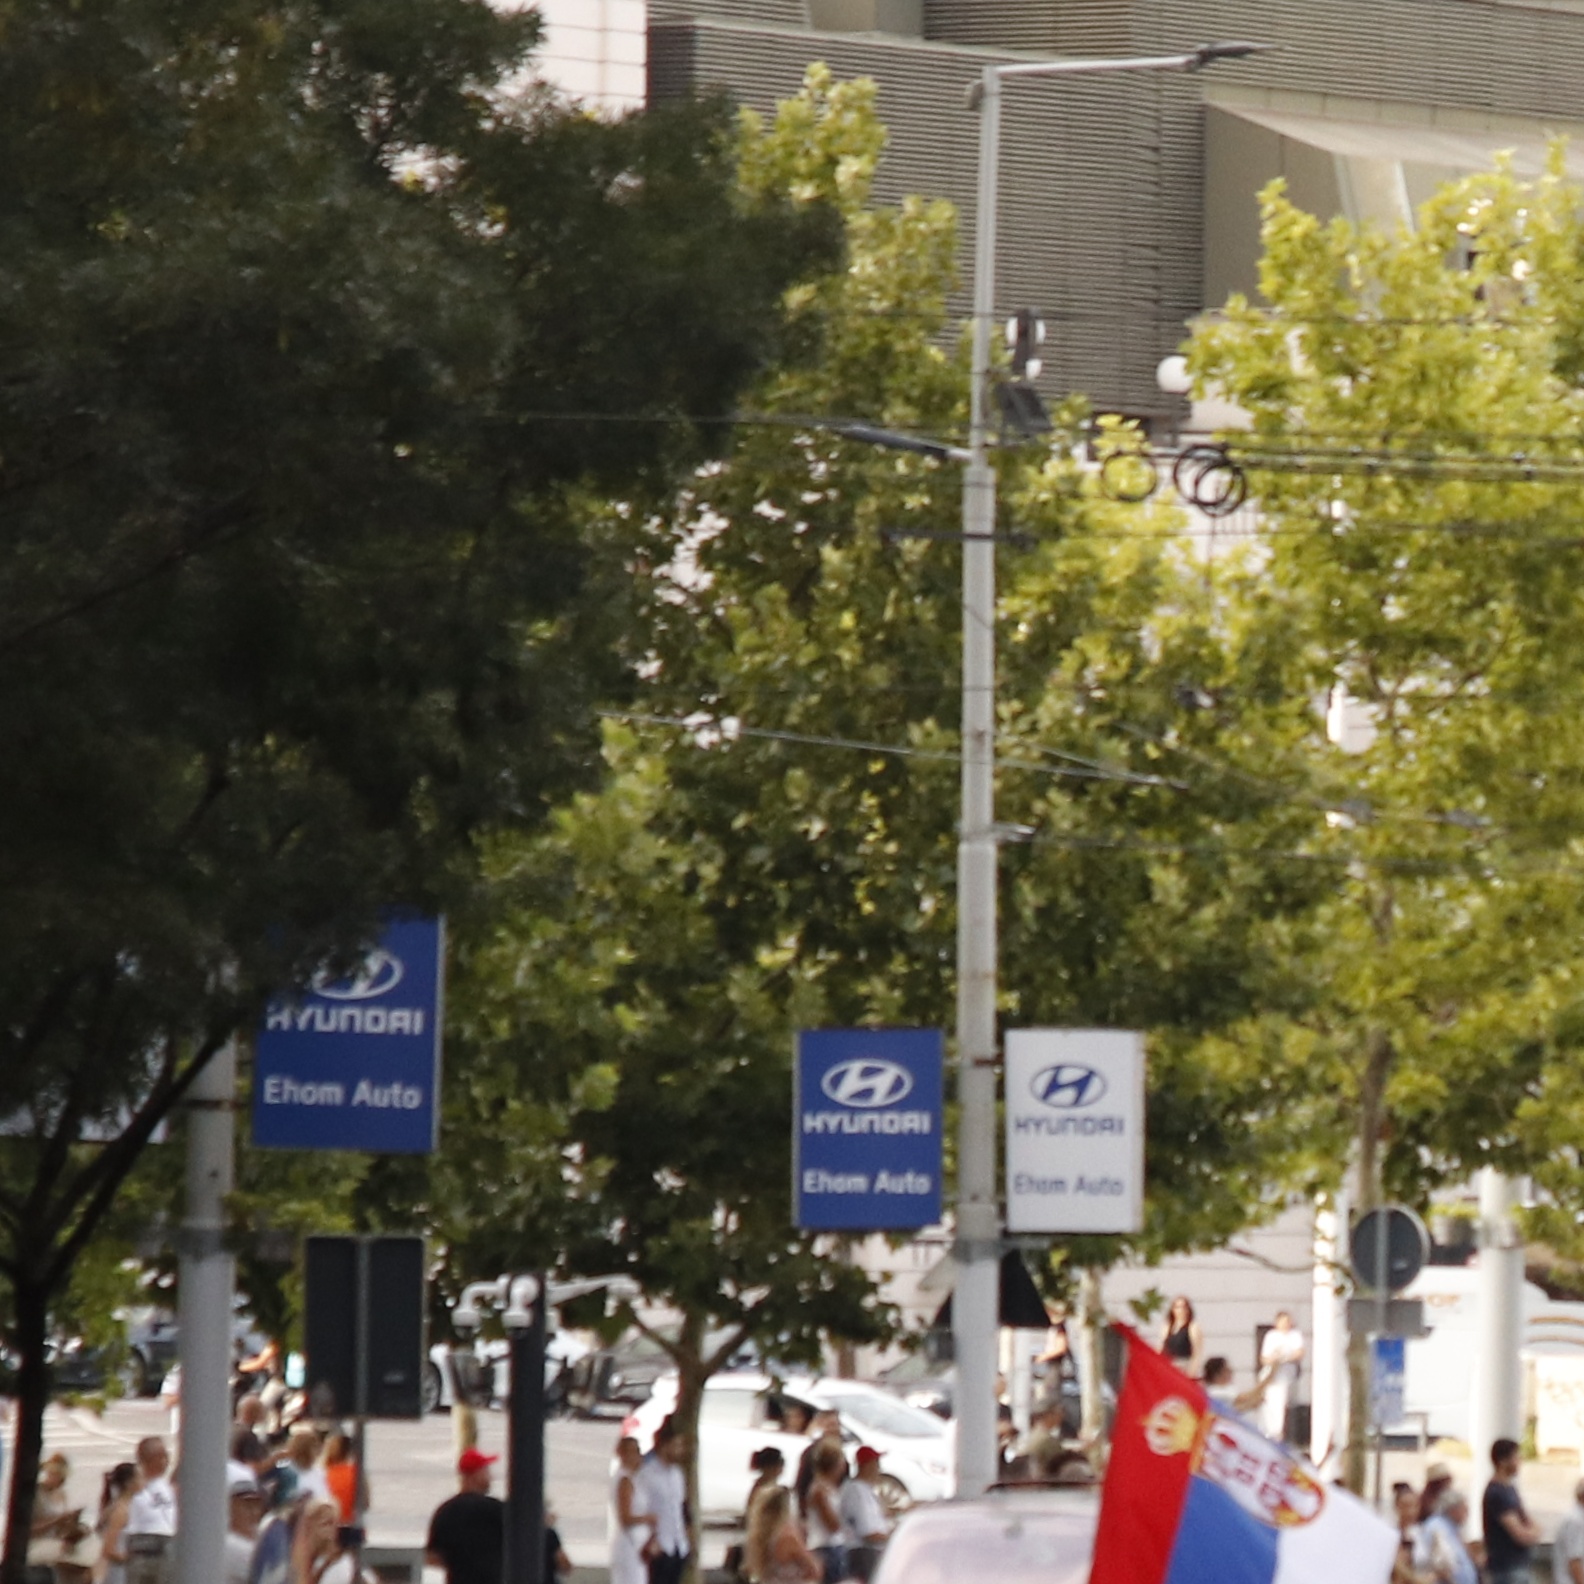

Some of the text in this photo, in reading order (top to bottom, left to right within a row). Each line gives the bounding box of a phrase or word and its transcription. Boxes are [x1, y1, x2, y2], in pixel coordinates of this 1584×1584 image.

[266, 1003, 424, 1035] HYUNDAI
[352, 1079, 422, 1109] Auto
[803, 1111, 931, 1135] HYUNDAI
[1014, 1116, 1125, 1136] HYUNDAI
[803, 1169, 931, 1195] Ehom Auto
[1013, 1174, 1125, 1198] Ehom Auto
